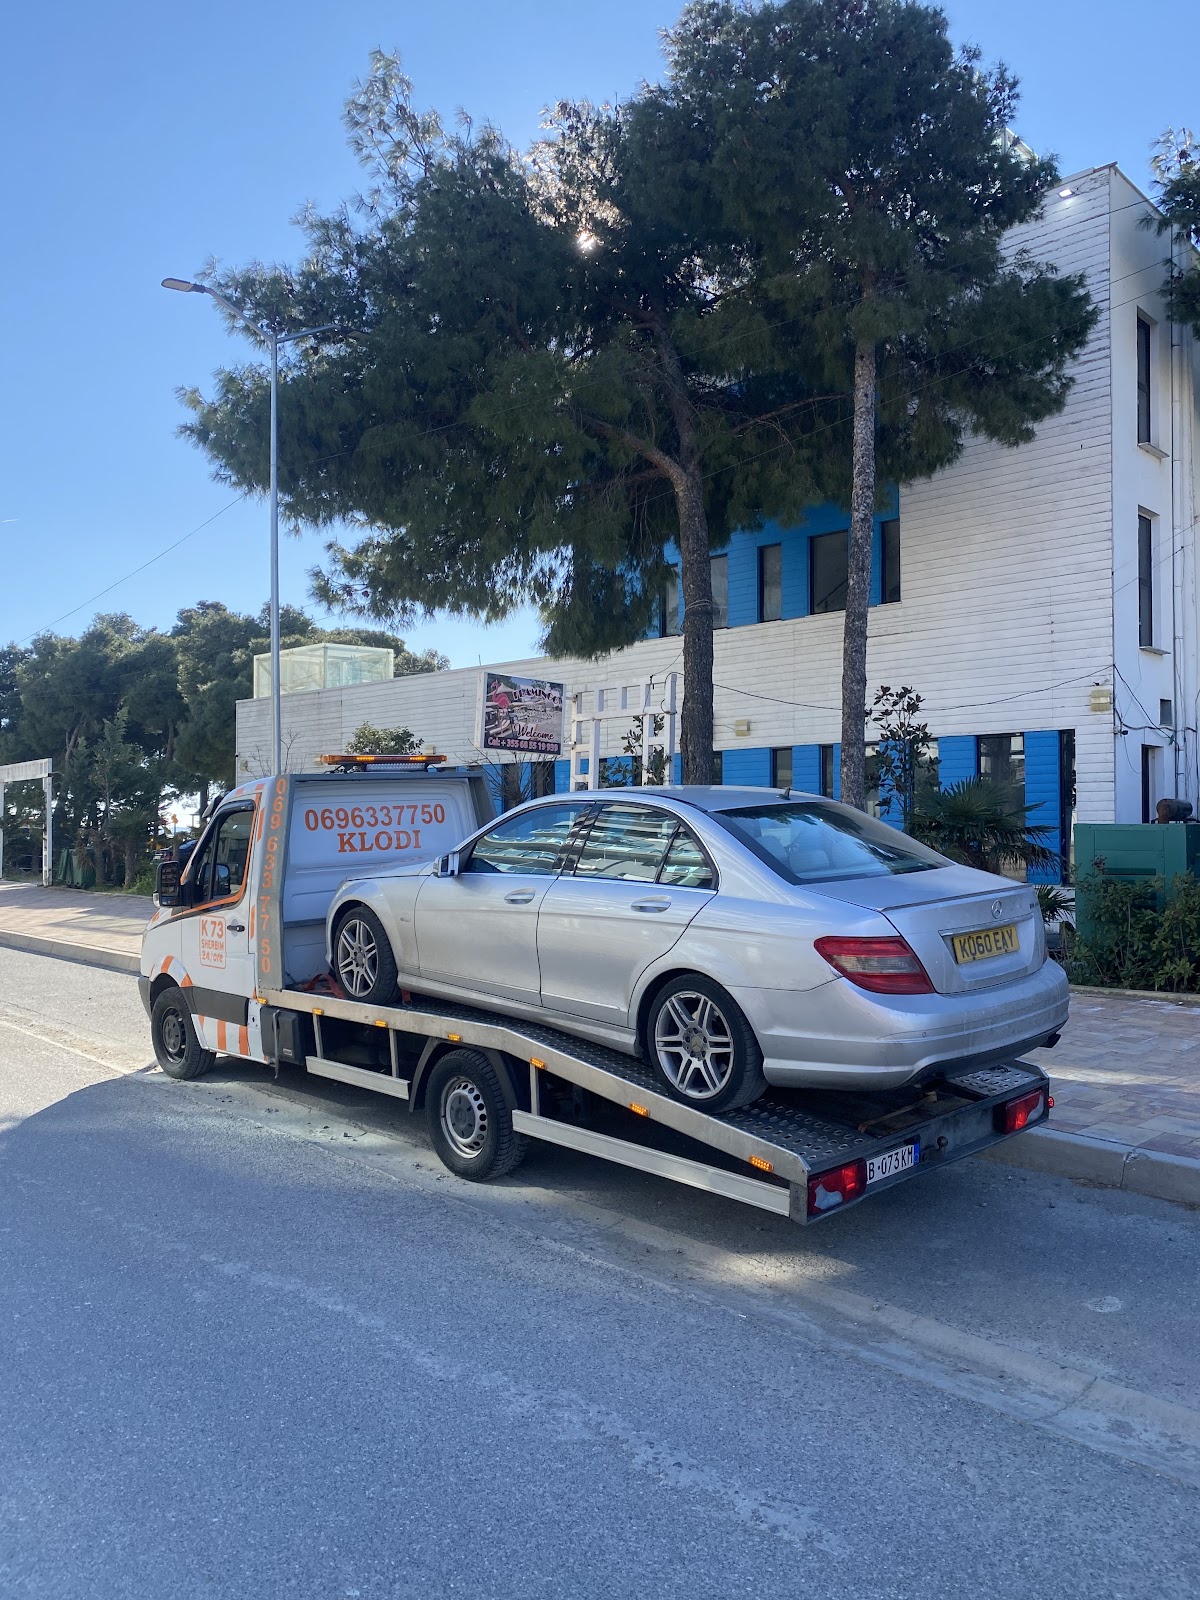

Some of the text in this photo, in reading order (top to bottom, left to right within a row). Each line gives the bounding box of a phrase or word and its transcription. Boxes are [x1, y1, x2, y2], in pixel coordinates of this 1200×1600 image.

[513, 723, 554, 740] Welcome
[506, 739, 519, 748] 355
[538, 742, 546, 750] 19
[304, 803, 446, 832] 0696337750
[337, 830, 421, 853] KLODI
[201, 938, 224, 951] SHERBIM
[993, 928, 1014, 951] EAY
